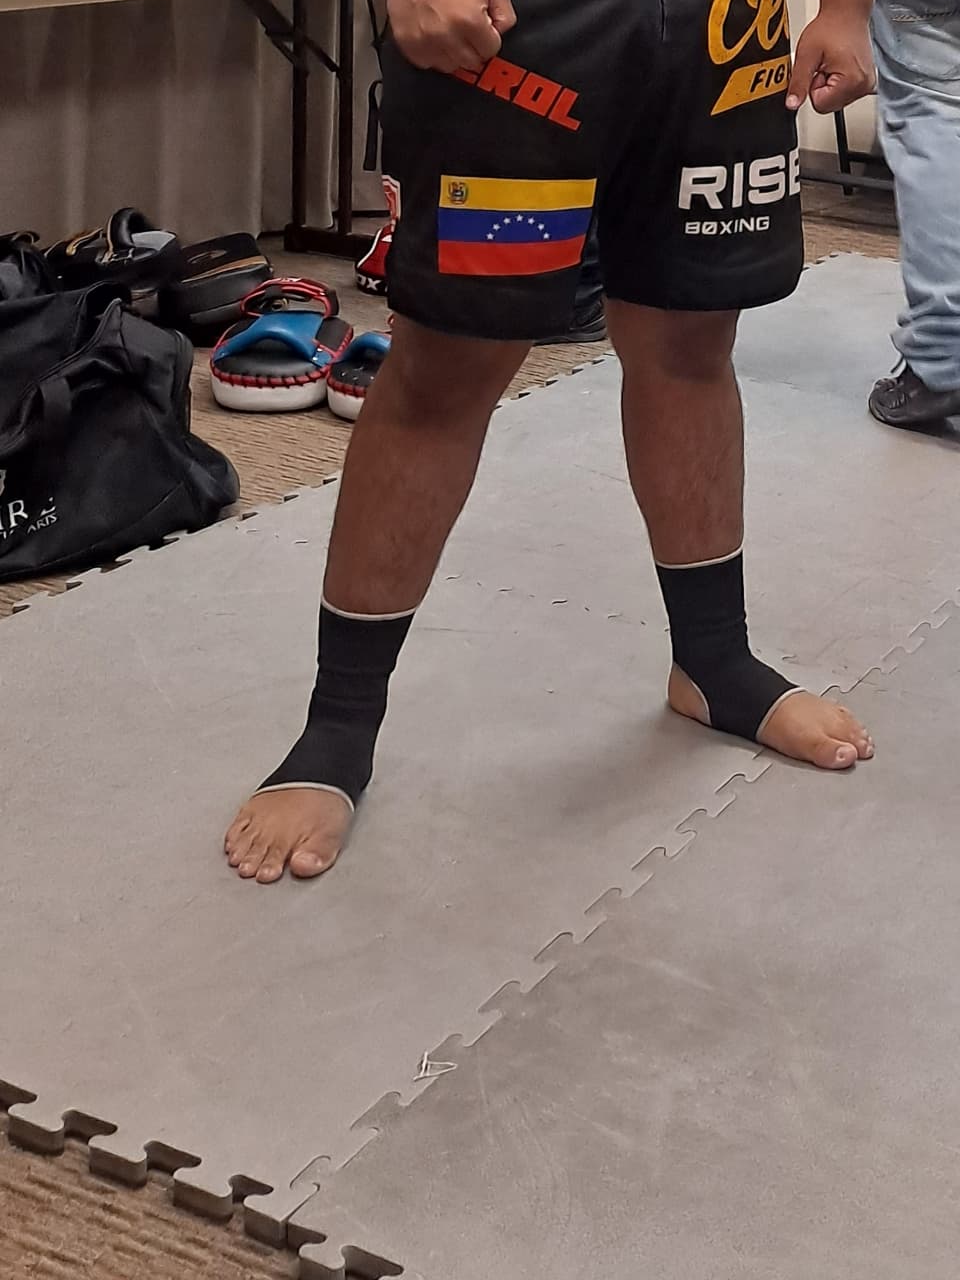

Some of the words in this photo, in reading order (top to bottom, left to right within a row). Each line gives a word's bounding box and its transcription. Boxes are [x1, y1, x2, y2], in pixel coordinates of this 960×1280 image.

[452, 56, 582, 131] ROL
[750, 63, 791, 93] FIG
[678, 149, 800, 210] RISE
